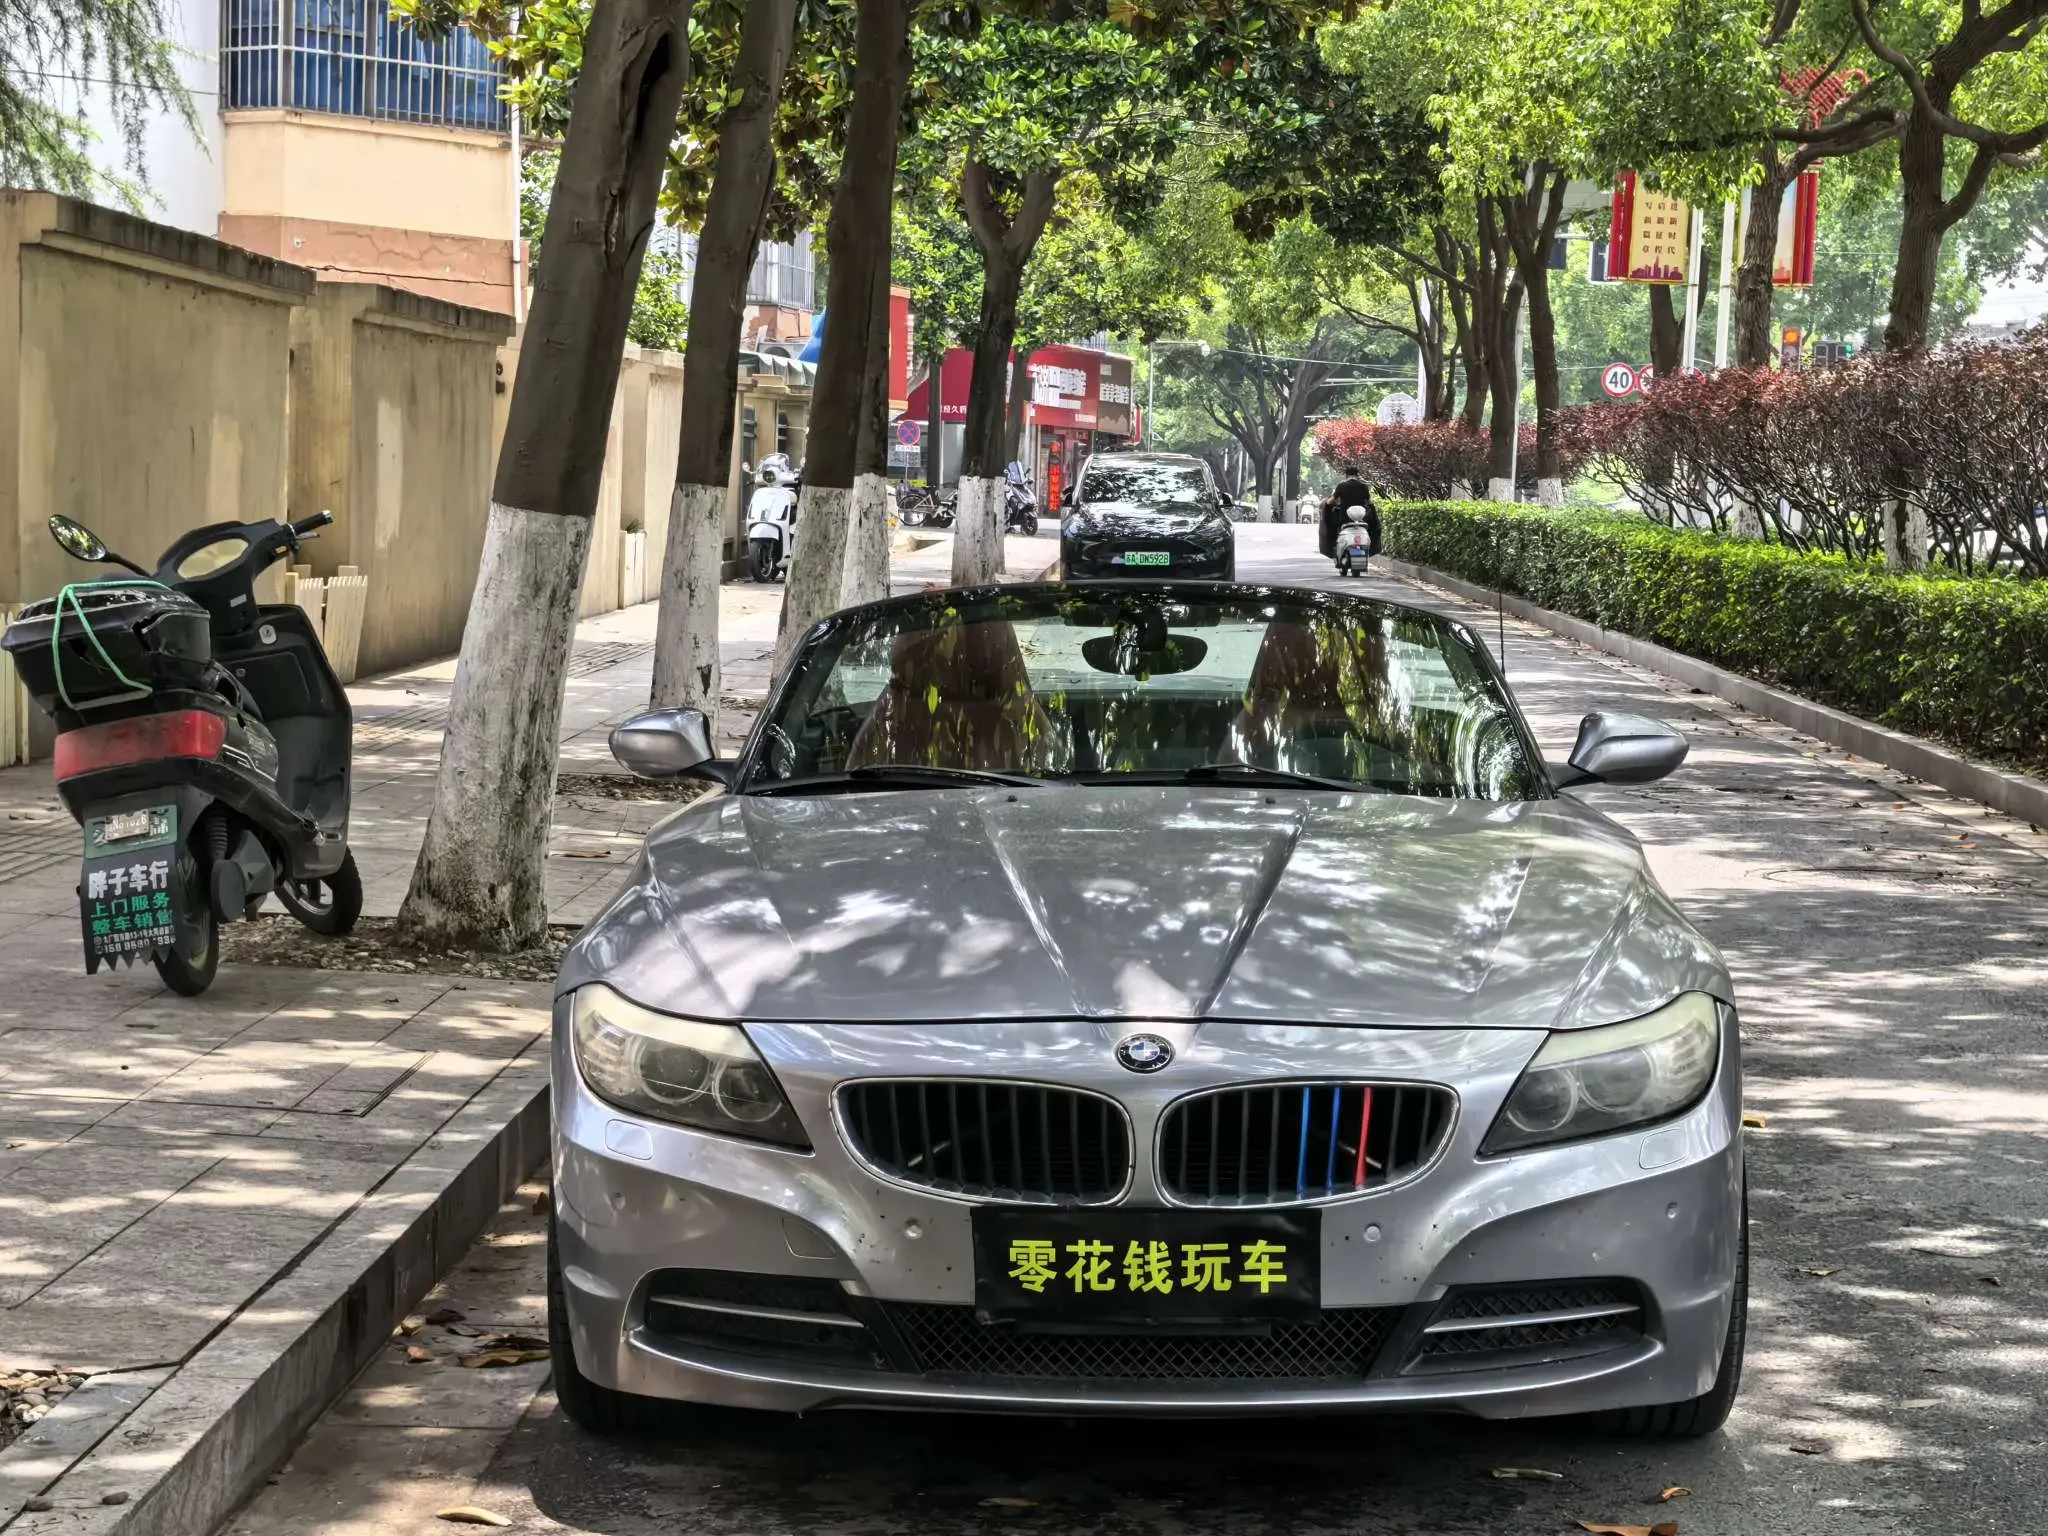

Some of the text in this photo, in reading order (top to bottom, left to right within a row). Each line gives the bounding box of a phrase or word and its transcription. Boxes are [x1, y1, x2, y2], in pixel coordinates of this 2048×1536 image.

[1609, 371, 1629, 388] 40
[91, 892, 170, 918] 上门服务
[1008, 1239, 1288, 1294] 零花钱玩车
